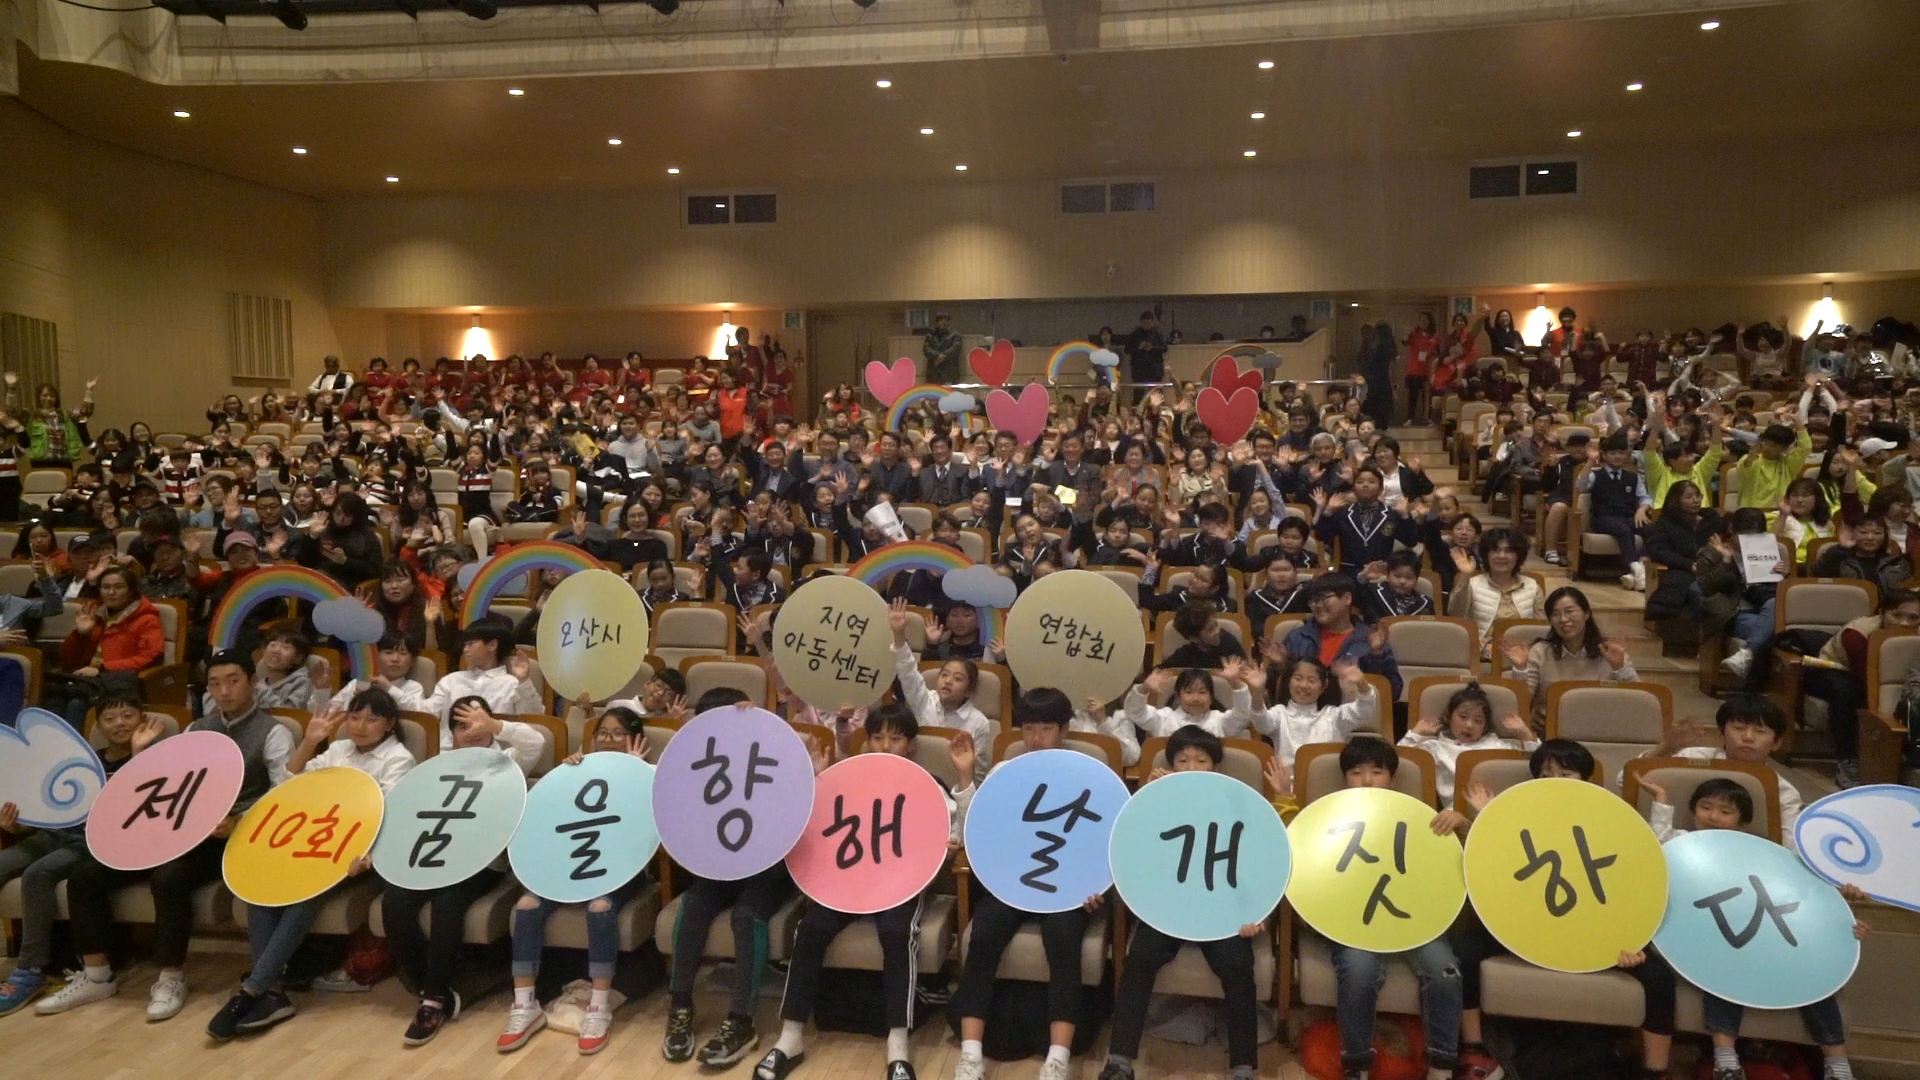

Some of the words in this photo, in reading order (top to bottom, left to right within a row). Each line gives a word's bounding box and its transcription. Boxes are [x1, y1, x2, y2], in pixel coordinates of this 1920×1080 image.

[561, 618, 622, 649] 오산시
[784, 633, 881, 689] 아동센터
[820, 606, 870, 643] 지역
[1040, 614, 1115, 664] 연합회
[121, 766, 208, 830] 제
[409, 775, 484, 868] 꿈
[555, 778, 621, 880] 을
[691, 736, 778, 852] 향
[249, 803, 362, 864] 10회
[822, 794, 903, 870] 해
[1021, 783, 1102, 893] 날
[1160, 821, 1244, 891] 개
[1328, 821, 1411, 925] 짓
[1514, 825, 1617, 917] 하
[1693, 874, 1798, 949] 다
